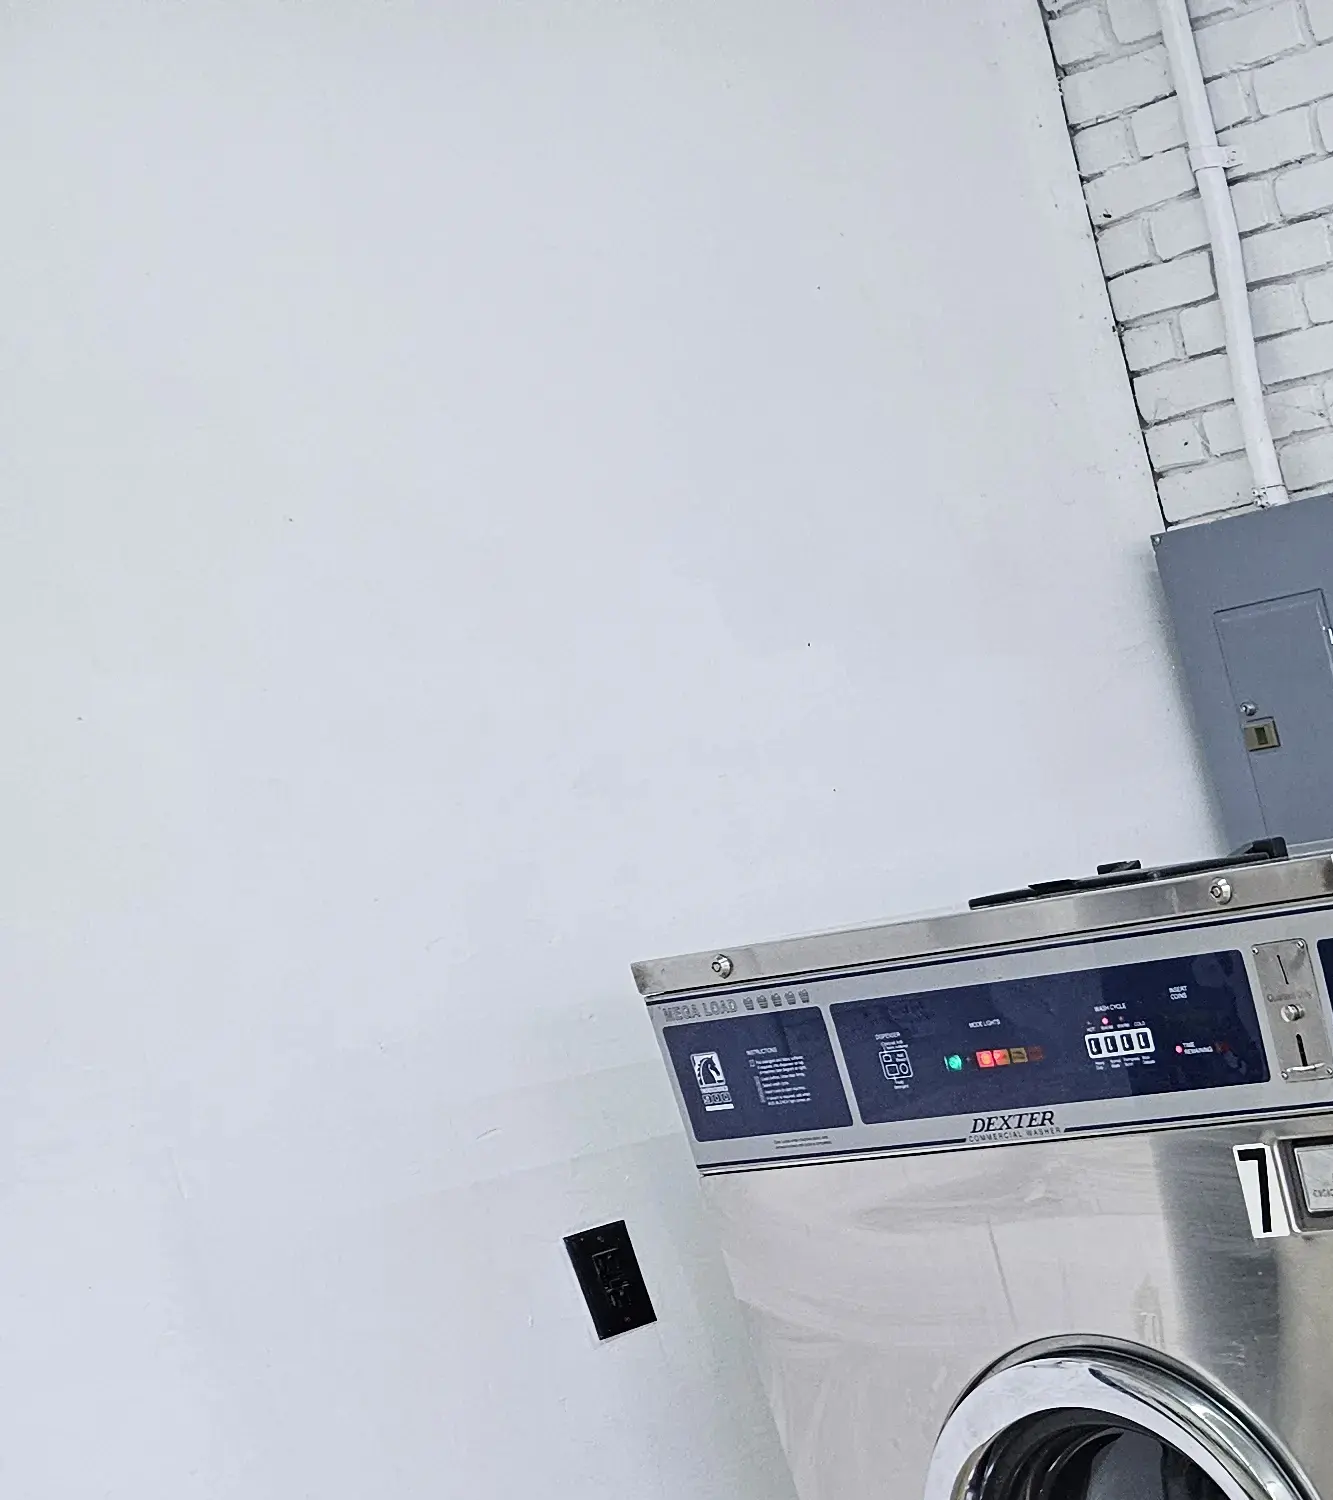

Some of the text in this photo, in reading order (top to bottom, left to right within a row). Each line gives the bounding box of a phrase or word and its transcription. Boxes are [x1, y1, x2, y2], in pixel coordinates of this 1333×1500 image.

[662, 999, 738, 1022] MEGA LOAD
[970, 1111, 1055, 1133] DEXTER
[969, 1127, 1060, 1142] COMMERCIAL WASHER
[1238, 1148, 1272, 1233] 7
